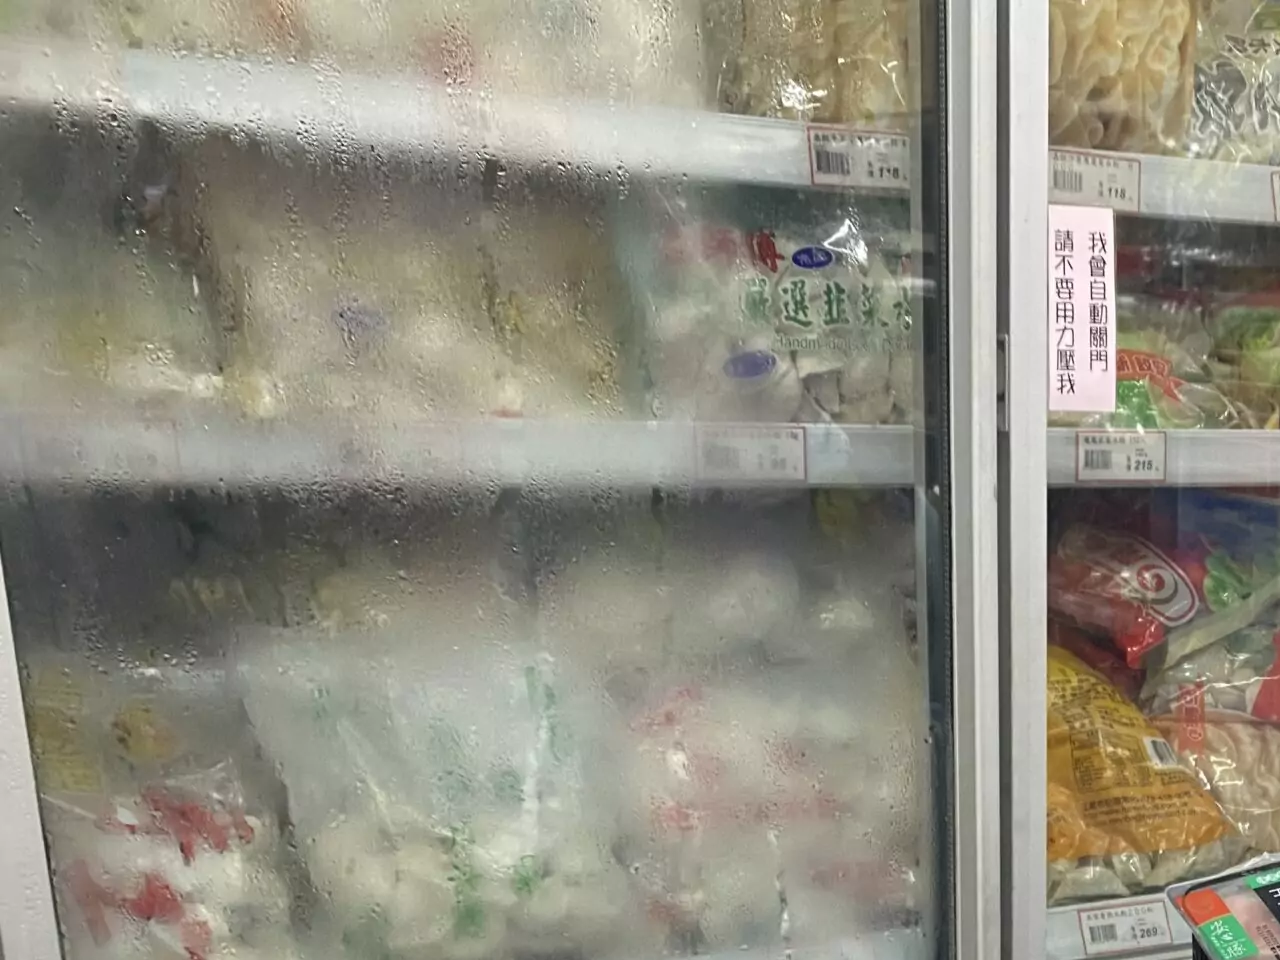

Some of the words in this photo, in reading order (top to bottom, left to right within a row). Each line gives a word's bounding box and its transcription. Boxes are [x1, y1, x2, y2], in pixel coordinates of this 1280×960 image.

[1054, 229, 1076, 395] 請不要用力壓我
[1088, 231, 1109, 373] 我會自動關門
[1134, 459, 1154, 472] 215
